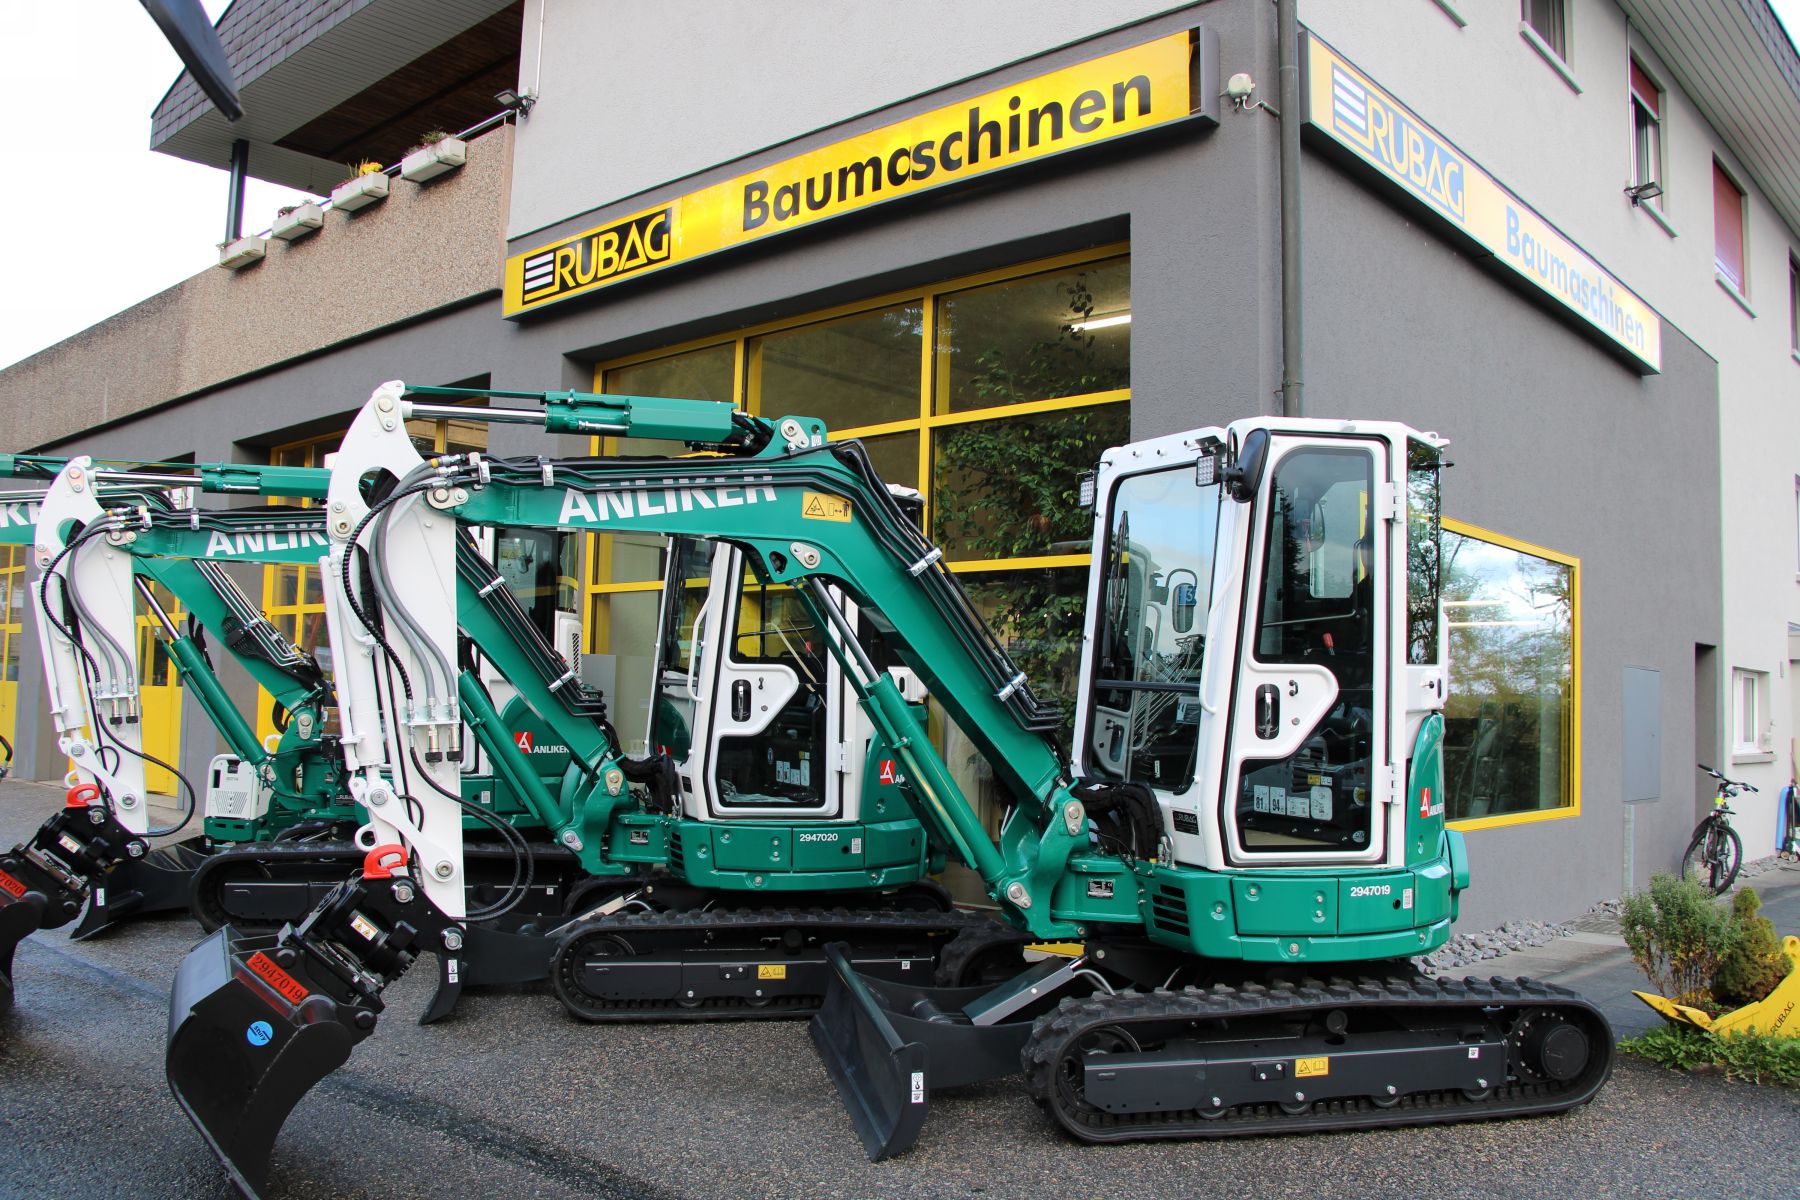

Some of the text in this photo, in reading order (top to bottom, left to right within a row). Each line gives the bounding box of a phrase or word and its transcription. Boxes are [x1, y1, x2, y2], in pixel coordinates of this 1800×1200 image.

[555, 74, 1152, 291] RUBAG Baumaschinen
[1367, 93, 1645, 350] RUBAG Baumaschinen
[558, 468, 777, 524] ANLIKER
[205, 522, 330, 557] ANLIK
[799, 833, 839, 842] 2947020
[1350, 884, 1391, 897] 2947019
[251, 956, 304, 1001] 2947019
